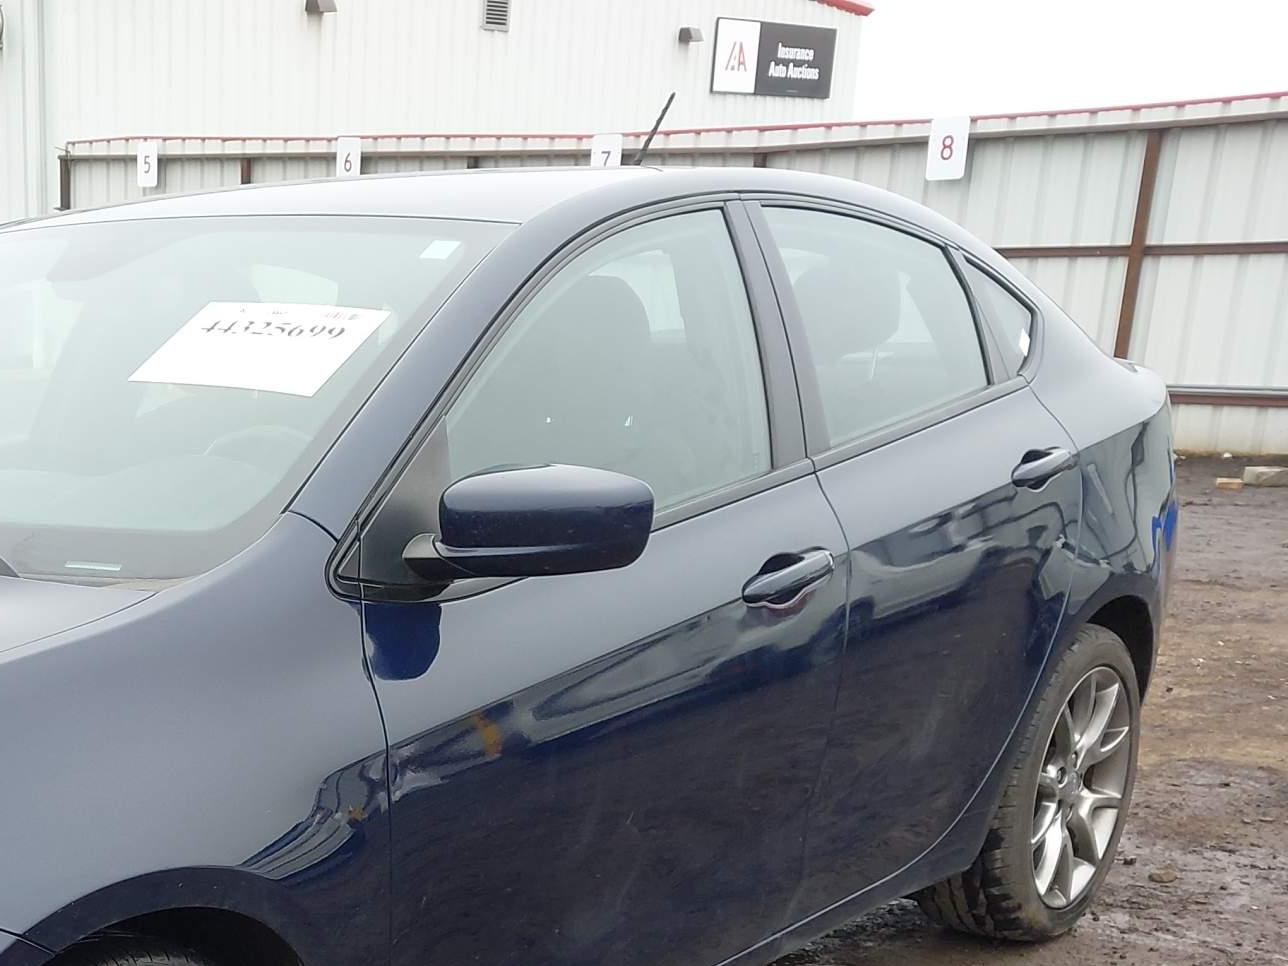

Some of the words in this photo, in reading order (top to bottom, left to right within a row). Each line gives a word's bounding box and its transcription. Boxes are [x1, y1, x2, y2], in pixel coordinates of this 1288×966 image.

[777, 42, 814, 61] Insurance
[768, 61, 787, 78] Auto
[787, 63, 819, 80] Auctions
[940, 135, 954, 161] 8
[144, 155, 151, 174] 5
[344, 152, 352, 172] 6
[601, 150, 611, 167] 7
[201, 320, 346, 339] 44325699
